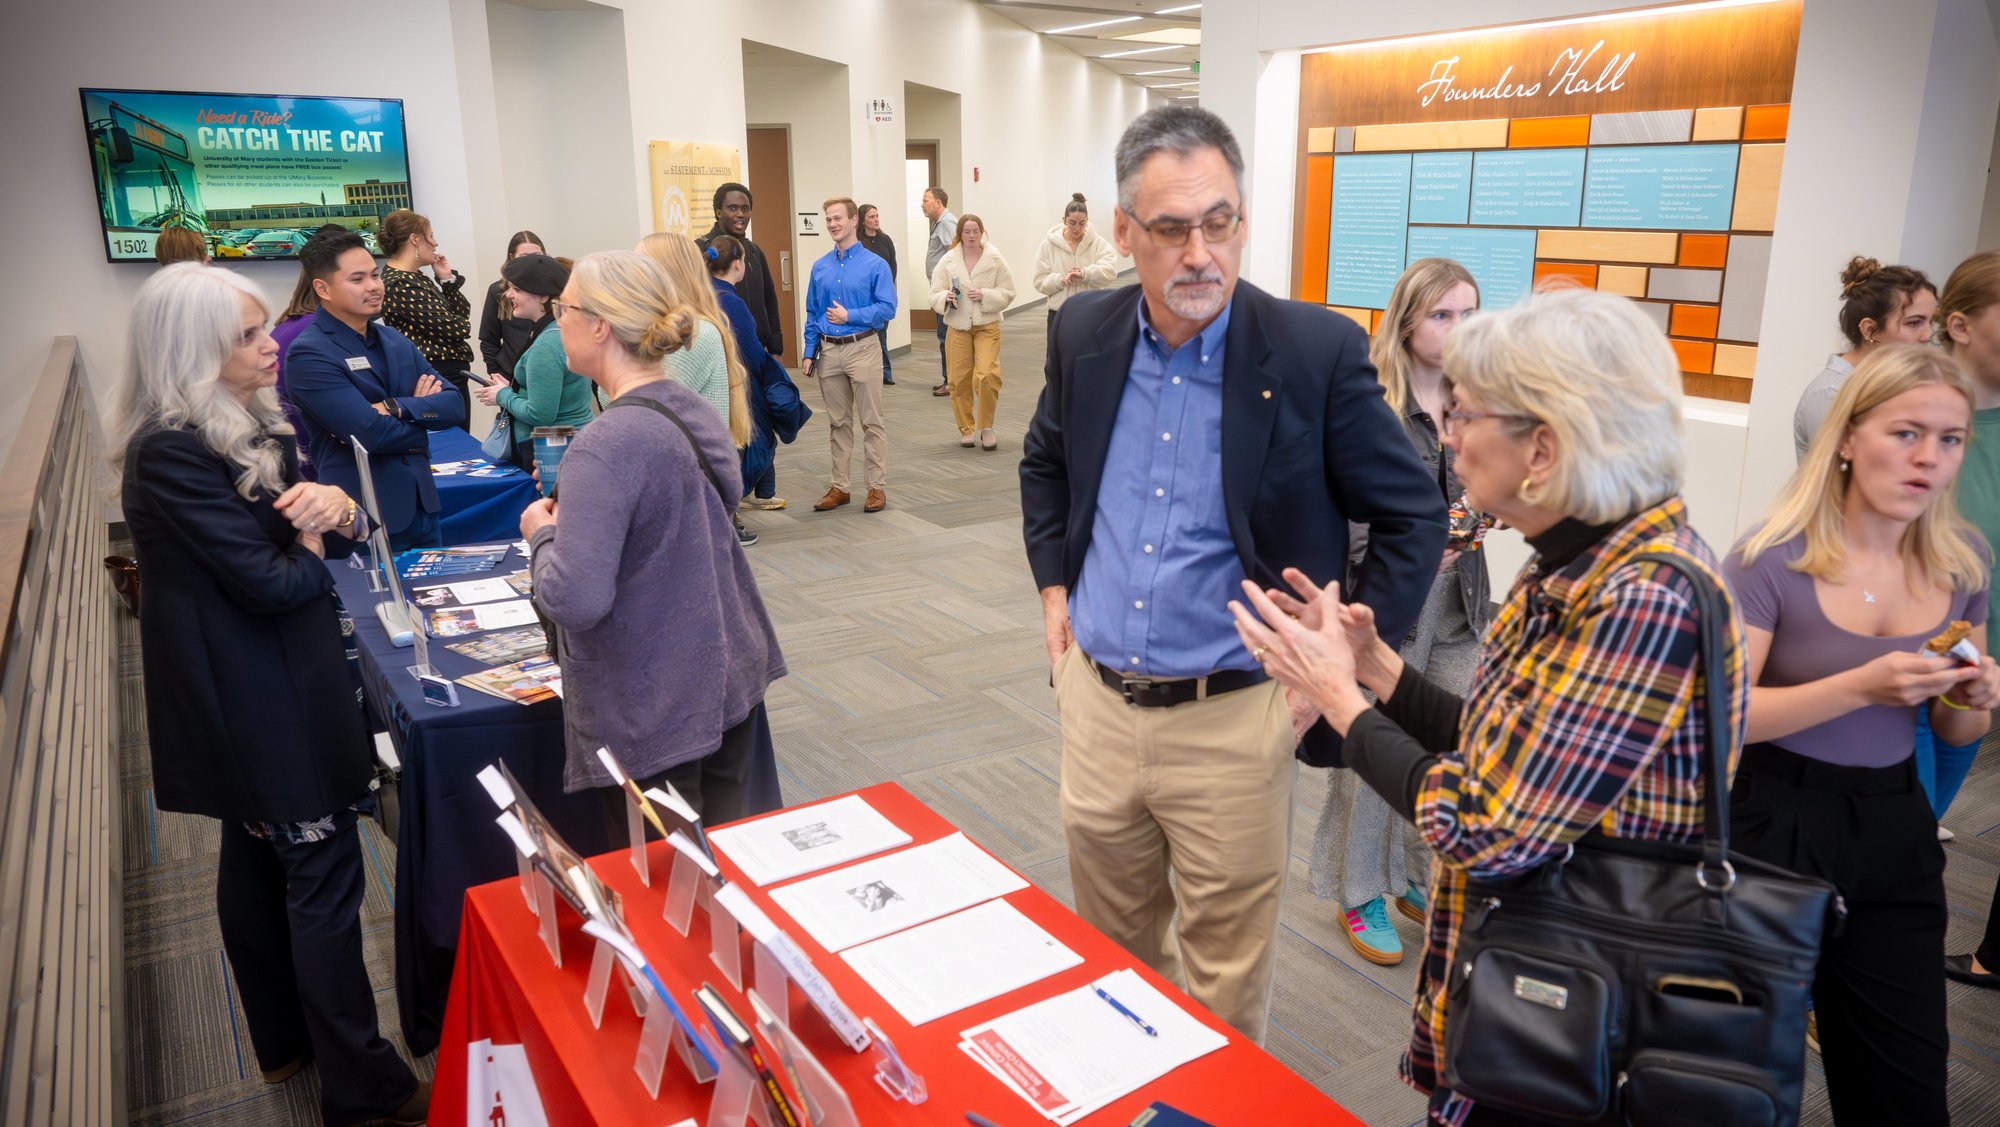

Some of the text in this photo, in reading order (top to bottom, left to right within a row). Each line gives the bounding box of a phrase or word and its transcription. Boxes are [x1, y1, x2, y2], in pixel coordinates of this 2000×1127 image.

[1417, 39, 1636, 108] Founders Hall
[196, 108, 293, 127] Need a Ride?
[197, 126, 384, 153] CATCH THE CAT
[670, 165, 705, 176] STATEMENT
[709, 166, 732, 176] MISSION
[113, 239, 148, 254] 1502
